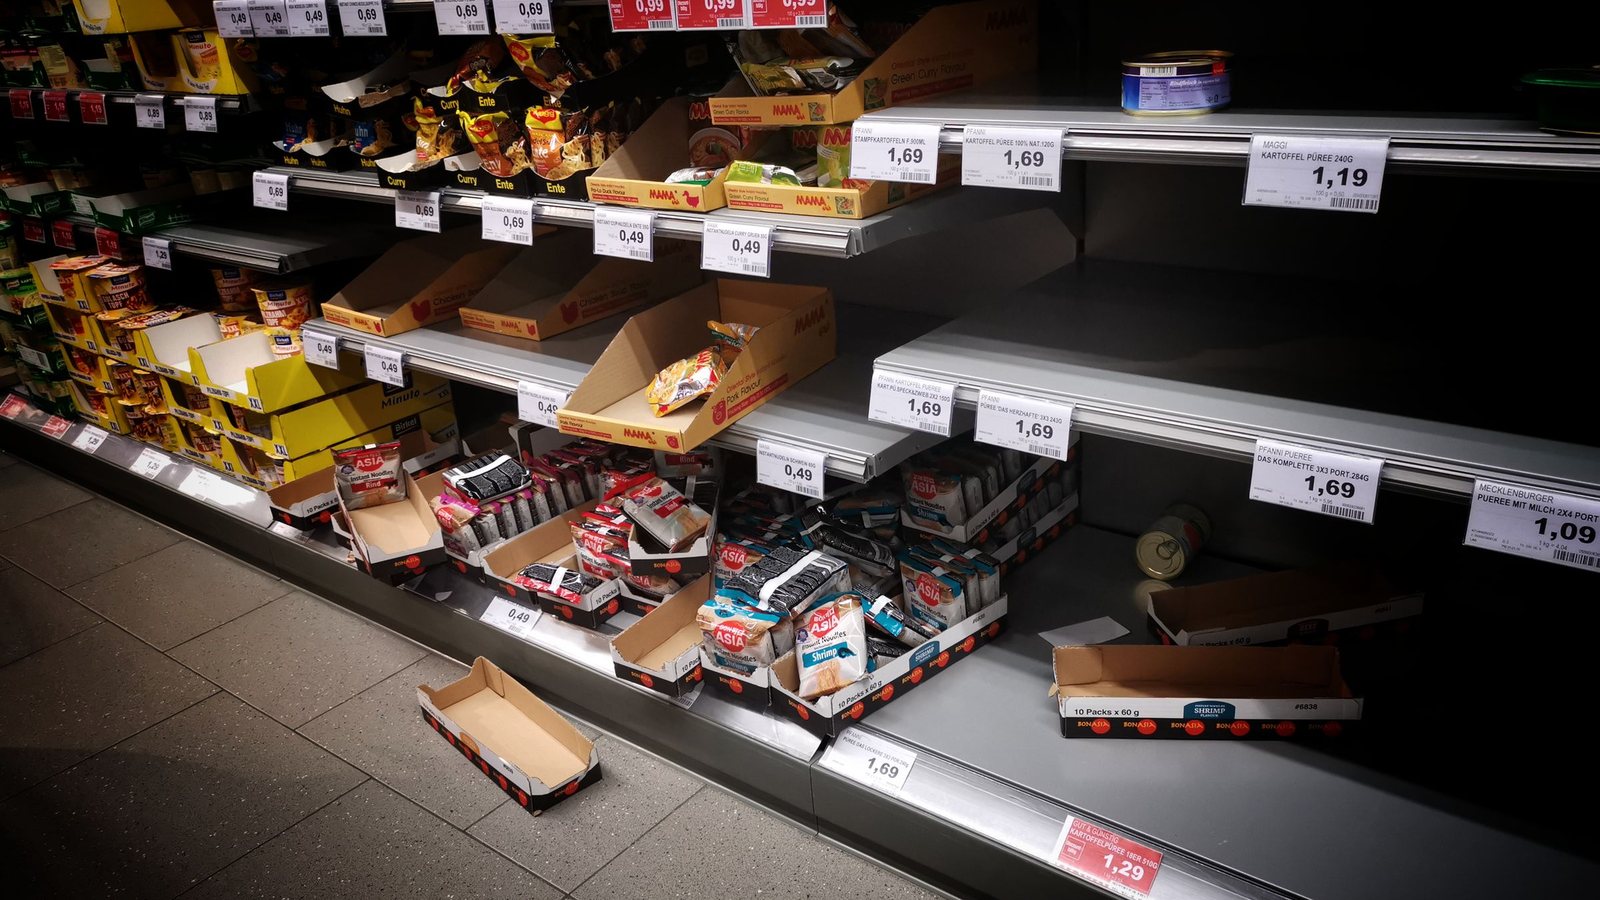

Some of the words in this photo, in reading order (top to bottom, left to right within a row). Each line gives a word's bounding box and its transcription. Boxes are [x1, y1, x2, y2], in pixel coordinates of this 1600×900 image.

[456, 4, 478, 19] 0,69
[519, 2, 543, 18] 0,69
[635, 0, 664, 15] 0,99
[704, 0, 735, 13] 0,99
[231, 13, 247, 24] 0,49
[265, 12, 282, 24] 0,49
[305, 10, 323, 22] 0,49
[357, 8, 377, 22] 0,69
[440, 99, 460, 110] Curry
[478, 96, 496, 107] Ente
[147, 109, 160, 119] 0,89
[199, 112, 212, 121] 0,89
[333, 105, 351, 117] Huhn
[773, 104, 801, 116] MAMA
[966, 128, 986, 136] PFANNI
[854, 136, 906, 145] STAMPFKARTOFFELN
[965, 137, 996, 146] KARTOFFEL
[996, 138, 1014, 147] PÜREE
[1262, 141, 1287, 150] MAGGI
[311, 157, 326, 168] Huhn
[888, 147, 923, 166] 1,69
[1004, 149, 1044, 169] 1,69
[1261, 151, 1305, 161] KARTOFFEL
[1307, 152, 1333, 162] PÜREE
[1334, 155, 1353, 163] 240G
[387, 175, 405, 188] Curry
[457, 173, 477, 186] Curry
[495, 178, 514, 190] Ente
[1312, 166, 1368, 189] 1,19
[268, 186, 284, 199] 0,69
[546, 182, 565, 194] Ente
[649, 189, 675, 200] MAMA
[796, 195, 826, 206] MAMA
[415, 204, 434, 217] 0,69
[503, 215, 524, 229] 0,69
[619, 229, 644, 244] 0,49
[732, 238, 761, 255] 0,49
[317, 343, 332, 354] 0,49
[381, 361, 398, 373] 0,49
[381, 388, 420, 409] Minuto
[726, 392, 740, 405] Pork
[740, 378, 762, 397] Flavour
[538, 400, 558, 414] 0,49
[908, 398, 942, 416] 1,69
[395, 416, 417, 431] Birkel
[1016, 420, 1053, 439] 1,69
[623, 428, 651, 440] MAMA
[1258, 445, 1283, 457] PFANNI
[1284, 451, 1312, 462] PUEREE
[355, 454, 385, 470] ASIA
[1257, 454, 1272, 464] DAS
[1272, 458, 1314, 472] KOMPLETTE
[1315, 465, 1329, 475] 3X3
[1329, 468, 1369, 482] PORT.284G
[350, 473, 370, 482] Instant
[370, 467, 394, 479] Noodles
[784, 464, 813, 481] 0,49
[365, 479, 382, 489] Rind
[911, 479, 937, 494] ASIA
[1304, 475, 1355, 499] 1,69
[1479, 483, 1554, 504] MECKLENBURGER
[306, 506, 313, 514] 10
[313, 500, 329, 511] Packs
[1477, 493, 1511, 507] PUEREE
[1512, 500, 1526, 510] MIT
[1528, 504, 1555, 515] MILCH
[1557, 508, 1573, 518] 2X4
[1574, 511, 1599, 523] PORT
[1535, 517, 1596, 544] 1,09
[720, 550, 746, 564] ASIA
[595, 597, 602, 605] 10
[602, 588, 618, 603] Packs
[917, 582, 940, 604] ASIA
[507, 608, 530, 623] 0,49
[811, 615, 839, 633] ASIA
[716, 631, 745, 647] ASIA
[731, 653, 757, 662] Noodles
[811, 647, 837, 662] Shrimp
[681, 664, 688, 672] 10
[838, 702, 846, 710] 10
[846, 690, 864, 706] Packs
[869, 682, 877, 691] 60
[877, 680, 882, 688] g
[1074, 708, 1084, 716] 10
[1086, 708, 1112, 716] Packs
[1121, 708, 1131, 716] 60
[1133, 709, 1139, 717] g
[1077, 720, 1110, 728] BONASIA
[1170, 721, 1204, 729] BONASIA
[868, 757, 899, 779] 1,69
[1072, 820, 1086, 830] GUT
[1069, 828, 1126, 856] KARTOFFELPÜREE
[1126, 850, 1141, 862] 18ER
[1141, 858, 1158, 870] 510G
[1103, 854, 1145, 881] 1,29
